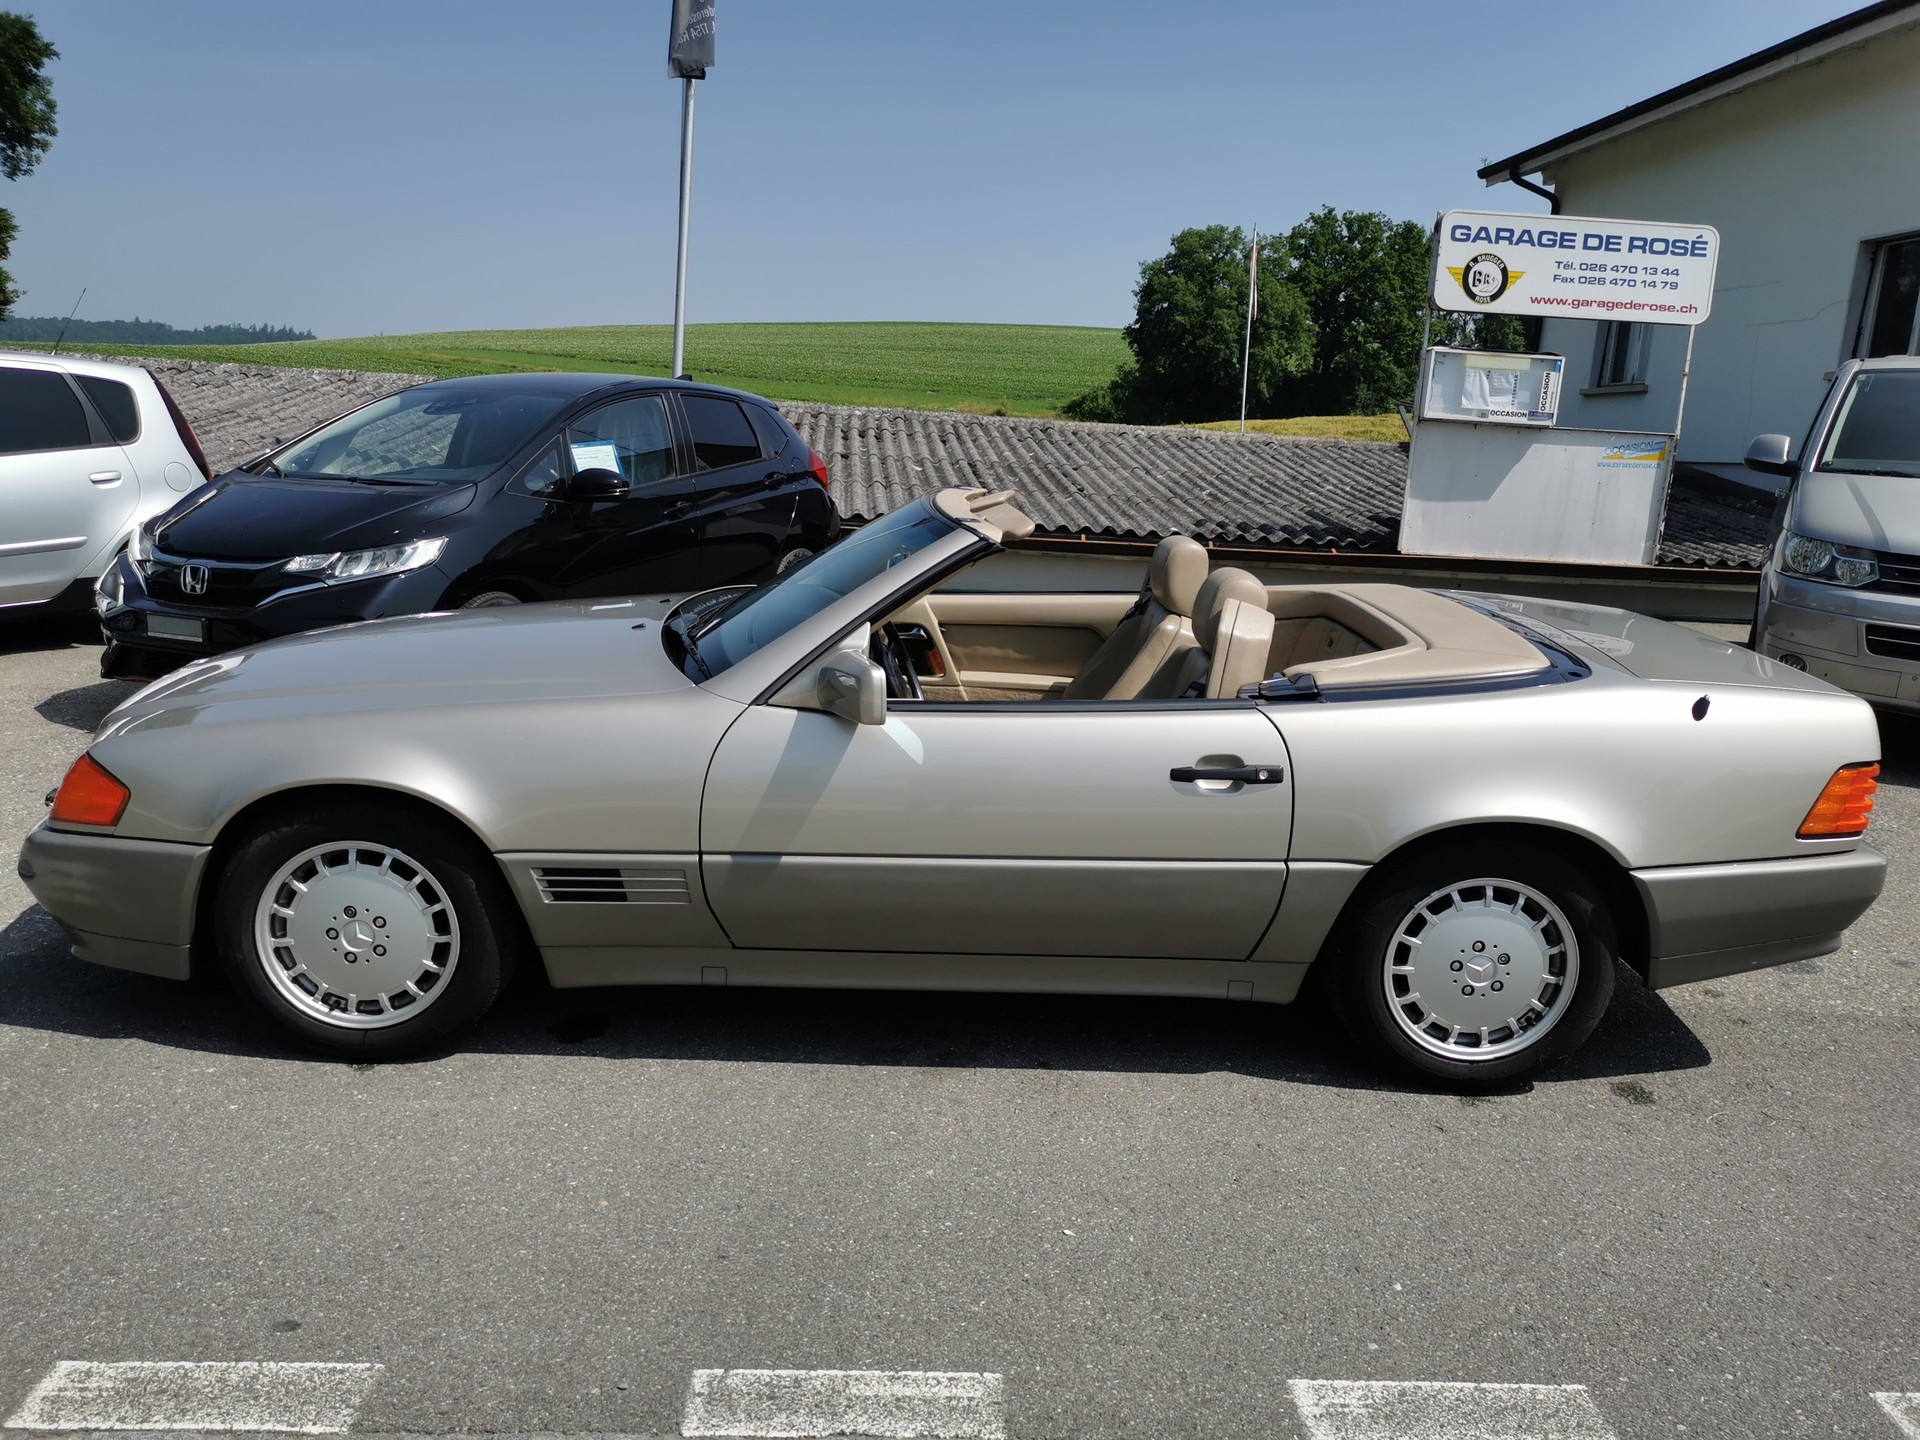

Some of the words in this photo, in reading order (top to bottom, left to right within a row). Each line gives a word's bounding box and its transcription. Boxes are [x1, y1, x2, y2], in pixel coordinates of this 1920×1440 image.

[1450, 224, 1577, 250] GARAGE
[1582, 233, 1623, 253] DE
[1627, 234, 1709, 258] ROSÉ
[1554, 260, 1576, 271] Tél.
[1579, 262, 1608, 273] 026
[1610, 265, 1638, 275] 470
[1641, 267, 1658, 276] 13
[1660, 268, 1680, 277] 44
[1552, 274, 1576, 284] Fax
[1578, 276, 1606, 286] 026
[1609, 278, 1637, 288] 470
[1640, 280, 1657, 289] 14
[1660, 281, 1679, 290] 79
[1530, 296, 1698, 314] www.garagederose.ch
[1541, 372, 1551, 411] OCCASION
[1490, 409, 1527, 418] OCCASION
[1605, 441, 1654, 455] OCCASION
